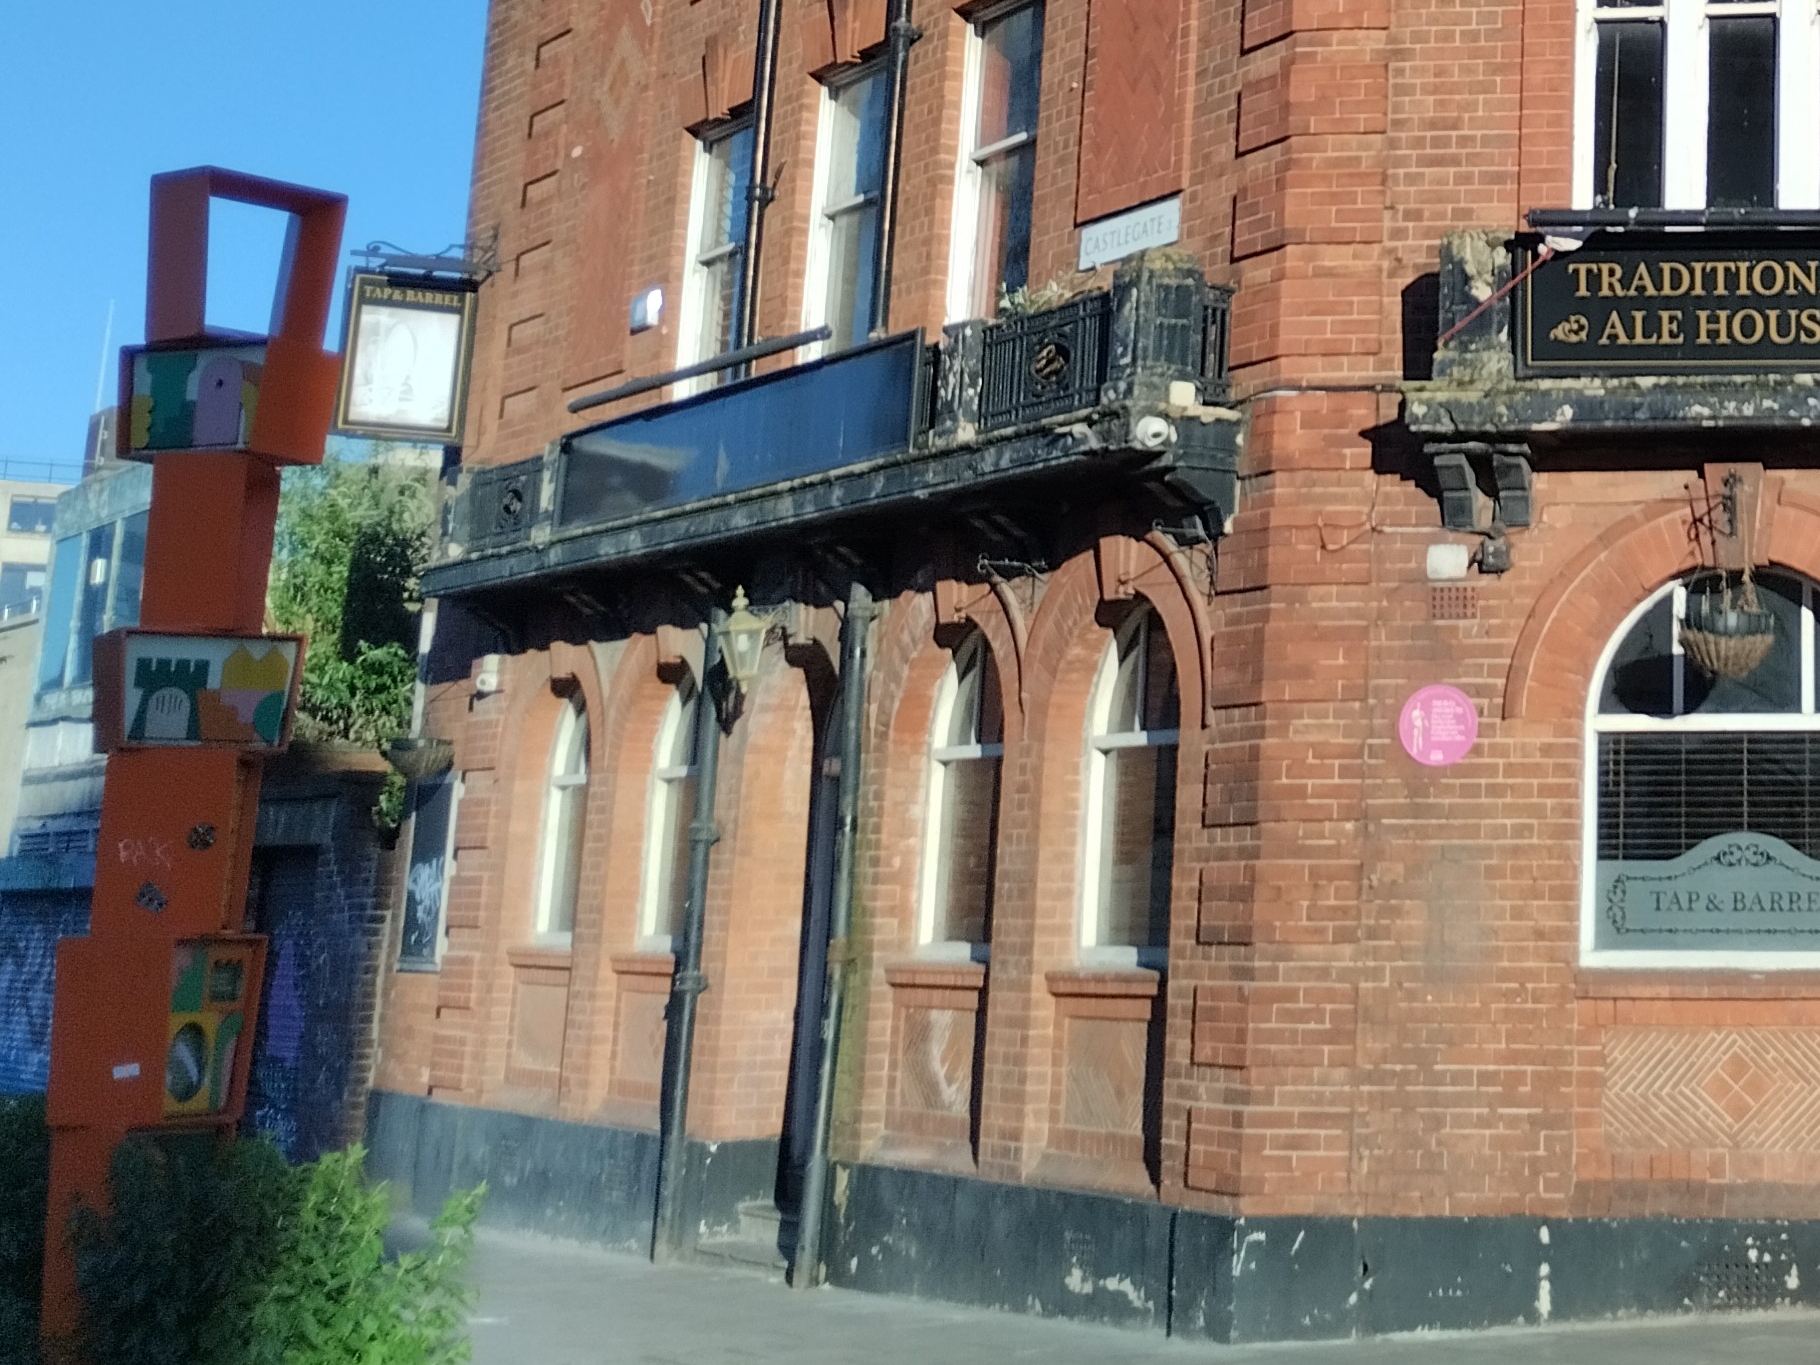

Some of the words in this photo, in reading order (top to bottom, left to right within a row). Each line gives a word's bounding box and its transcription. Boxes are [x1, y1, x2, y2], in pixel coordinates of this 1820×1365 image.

[1084, 214, 1165, 256] CASTLEGATE
[363, 286, 391, 300] TAP
[406, 289, 462, 306] BARREL
[1597, 309, 1684, 345] ALE
[1650, 890, 1701, 912] TAP
[1705, 893, 1724, 913] &
